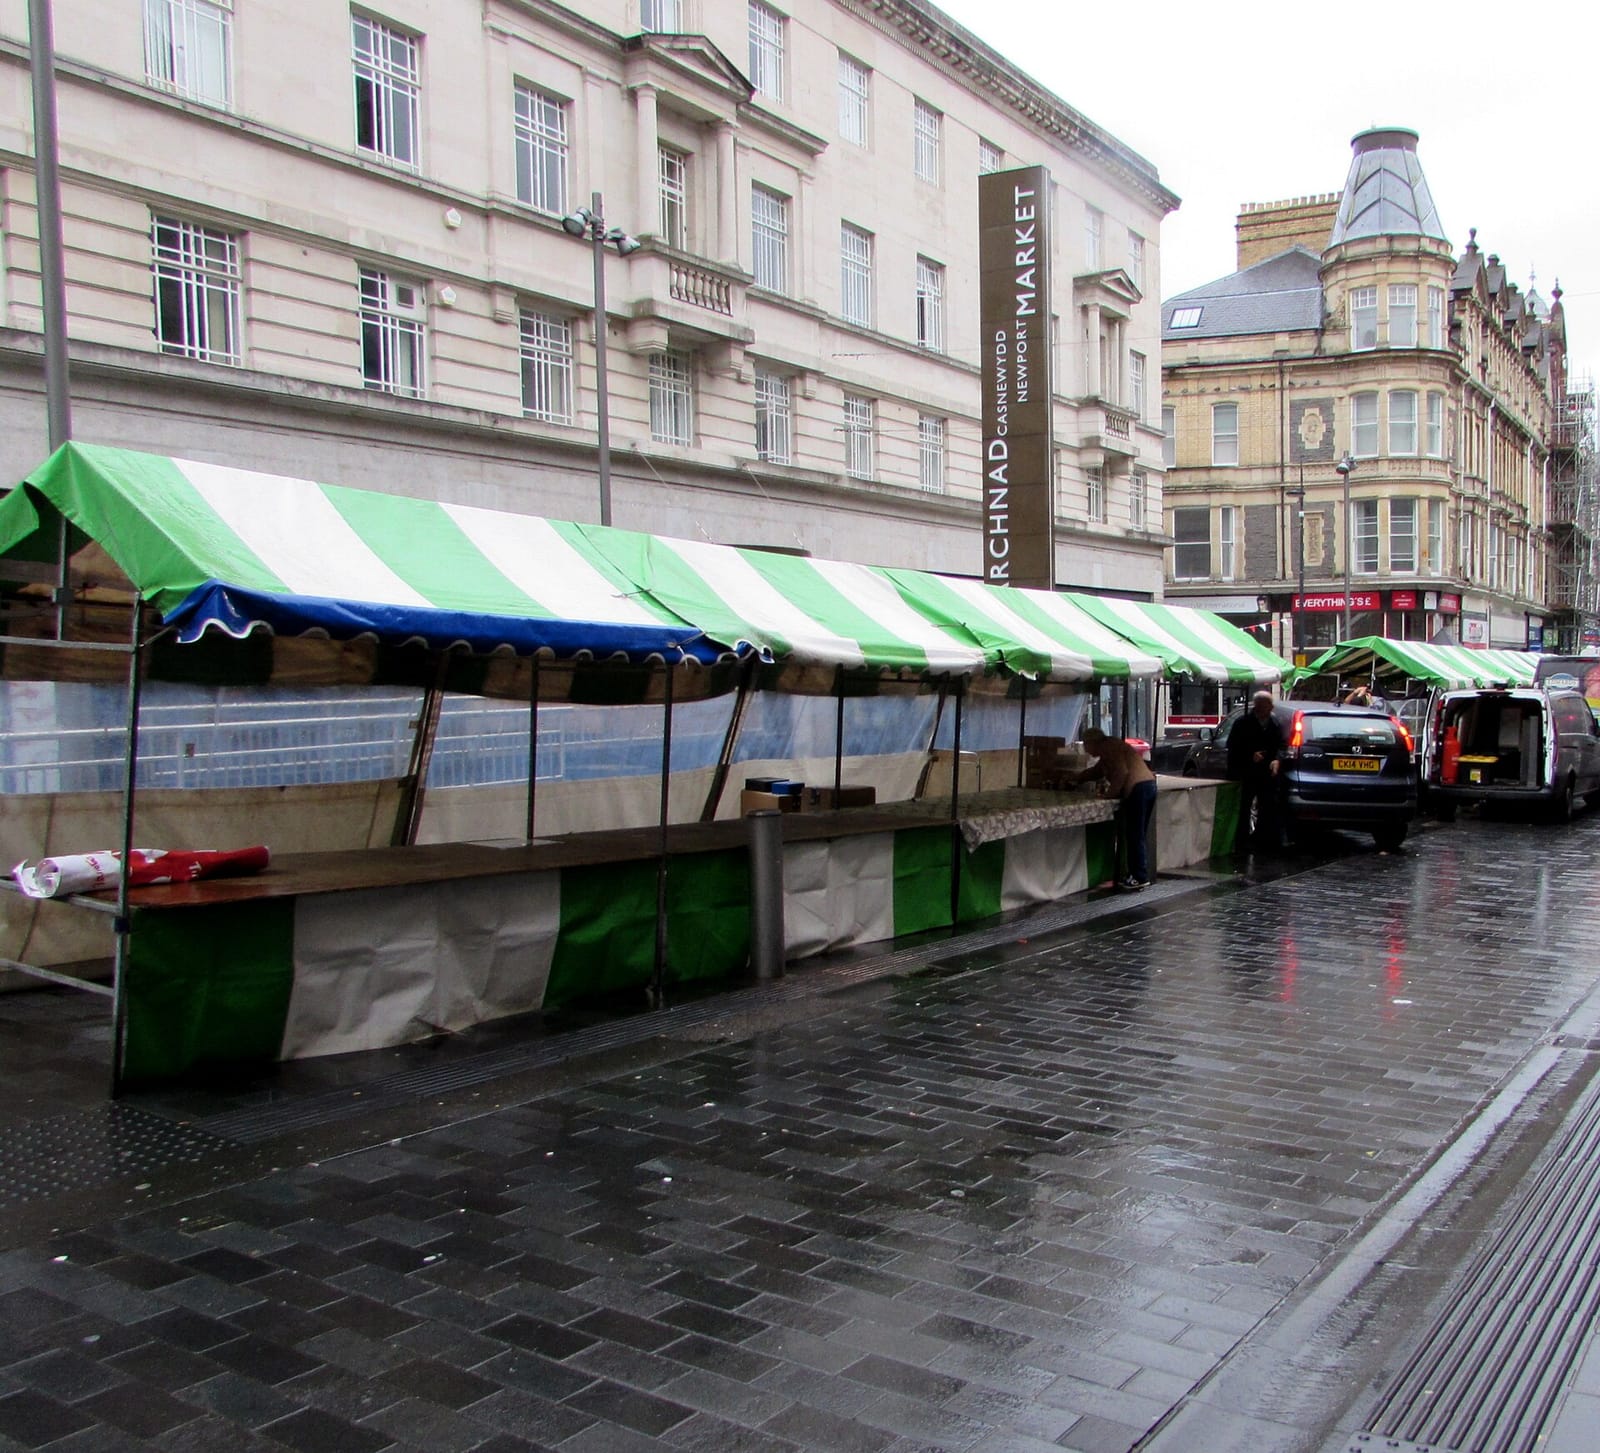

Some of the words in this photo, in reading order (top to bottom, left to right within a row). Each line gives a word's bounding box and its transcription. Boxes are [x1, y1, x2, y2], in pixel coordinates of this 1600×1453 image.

[1015, 186, 1036, 315] MARKET
[996, 330, 1008, 437] CASNEWYDD
[1016, 320, 1028, 402] NEWPORT
[988, 439, 1008, 586] RCHNAD
